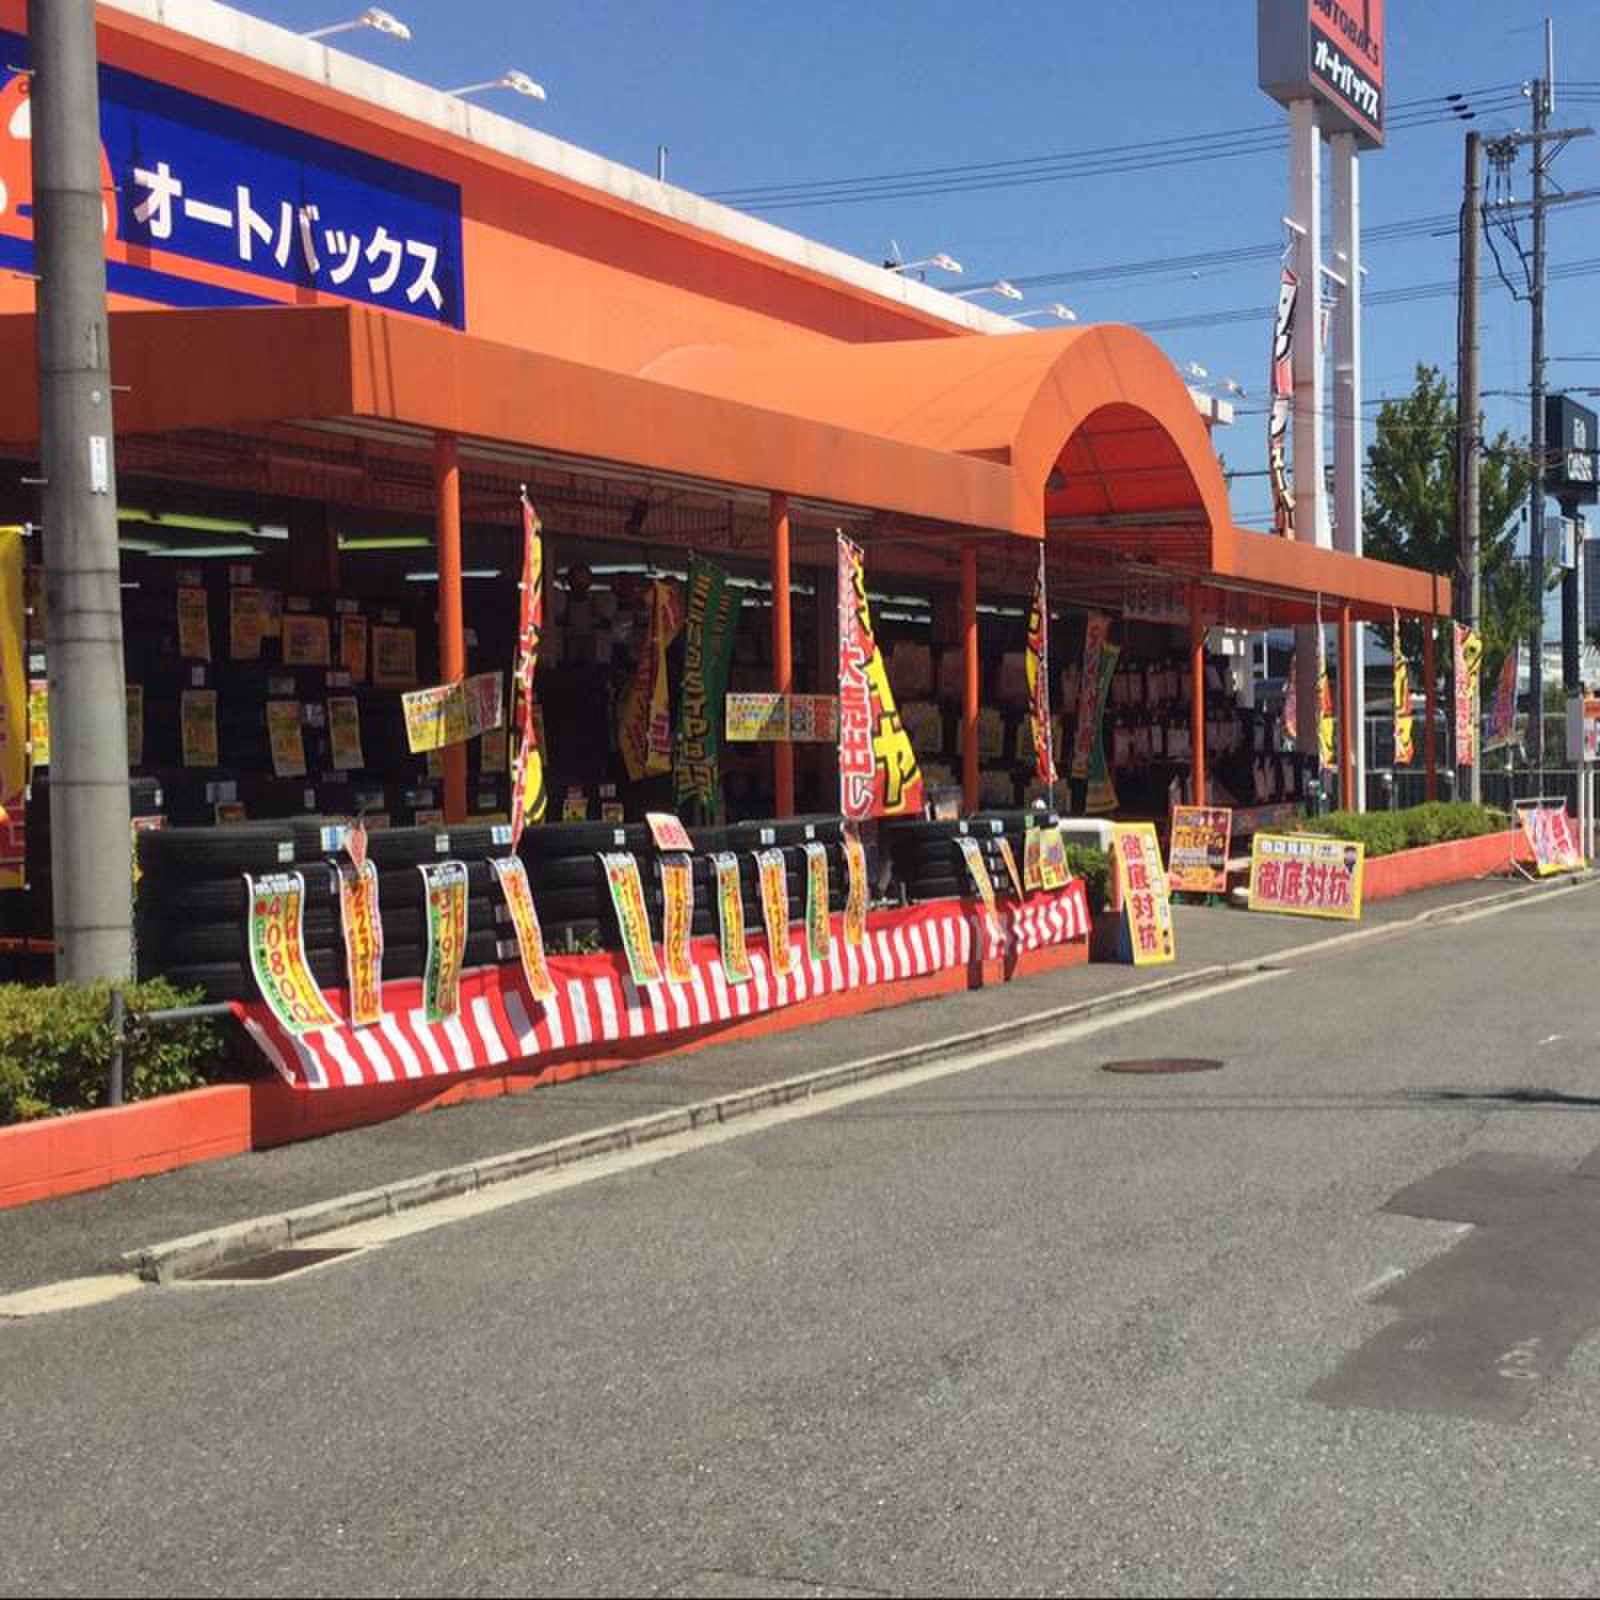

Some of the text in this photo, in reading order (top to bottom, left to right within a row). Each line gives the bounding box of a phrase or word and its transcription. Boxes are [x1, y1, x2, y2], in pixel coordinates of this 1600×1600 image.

[1315, 41, 1379, 120] オートバックス
[133, 162, 444, 310] オートバックス
[838, 642, 876, 818] 大売出し
[1120, 832, 1158, 951] 徹底対抗
[1258, 858, 1351, 907] 徹底対抗
